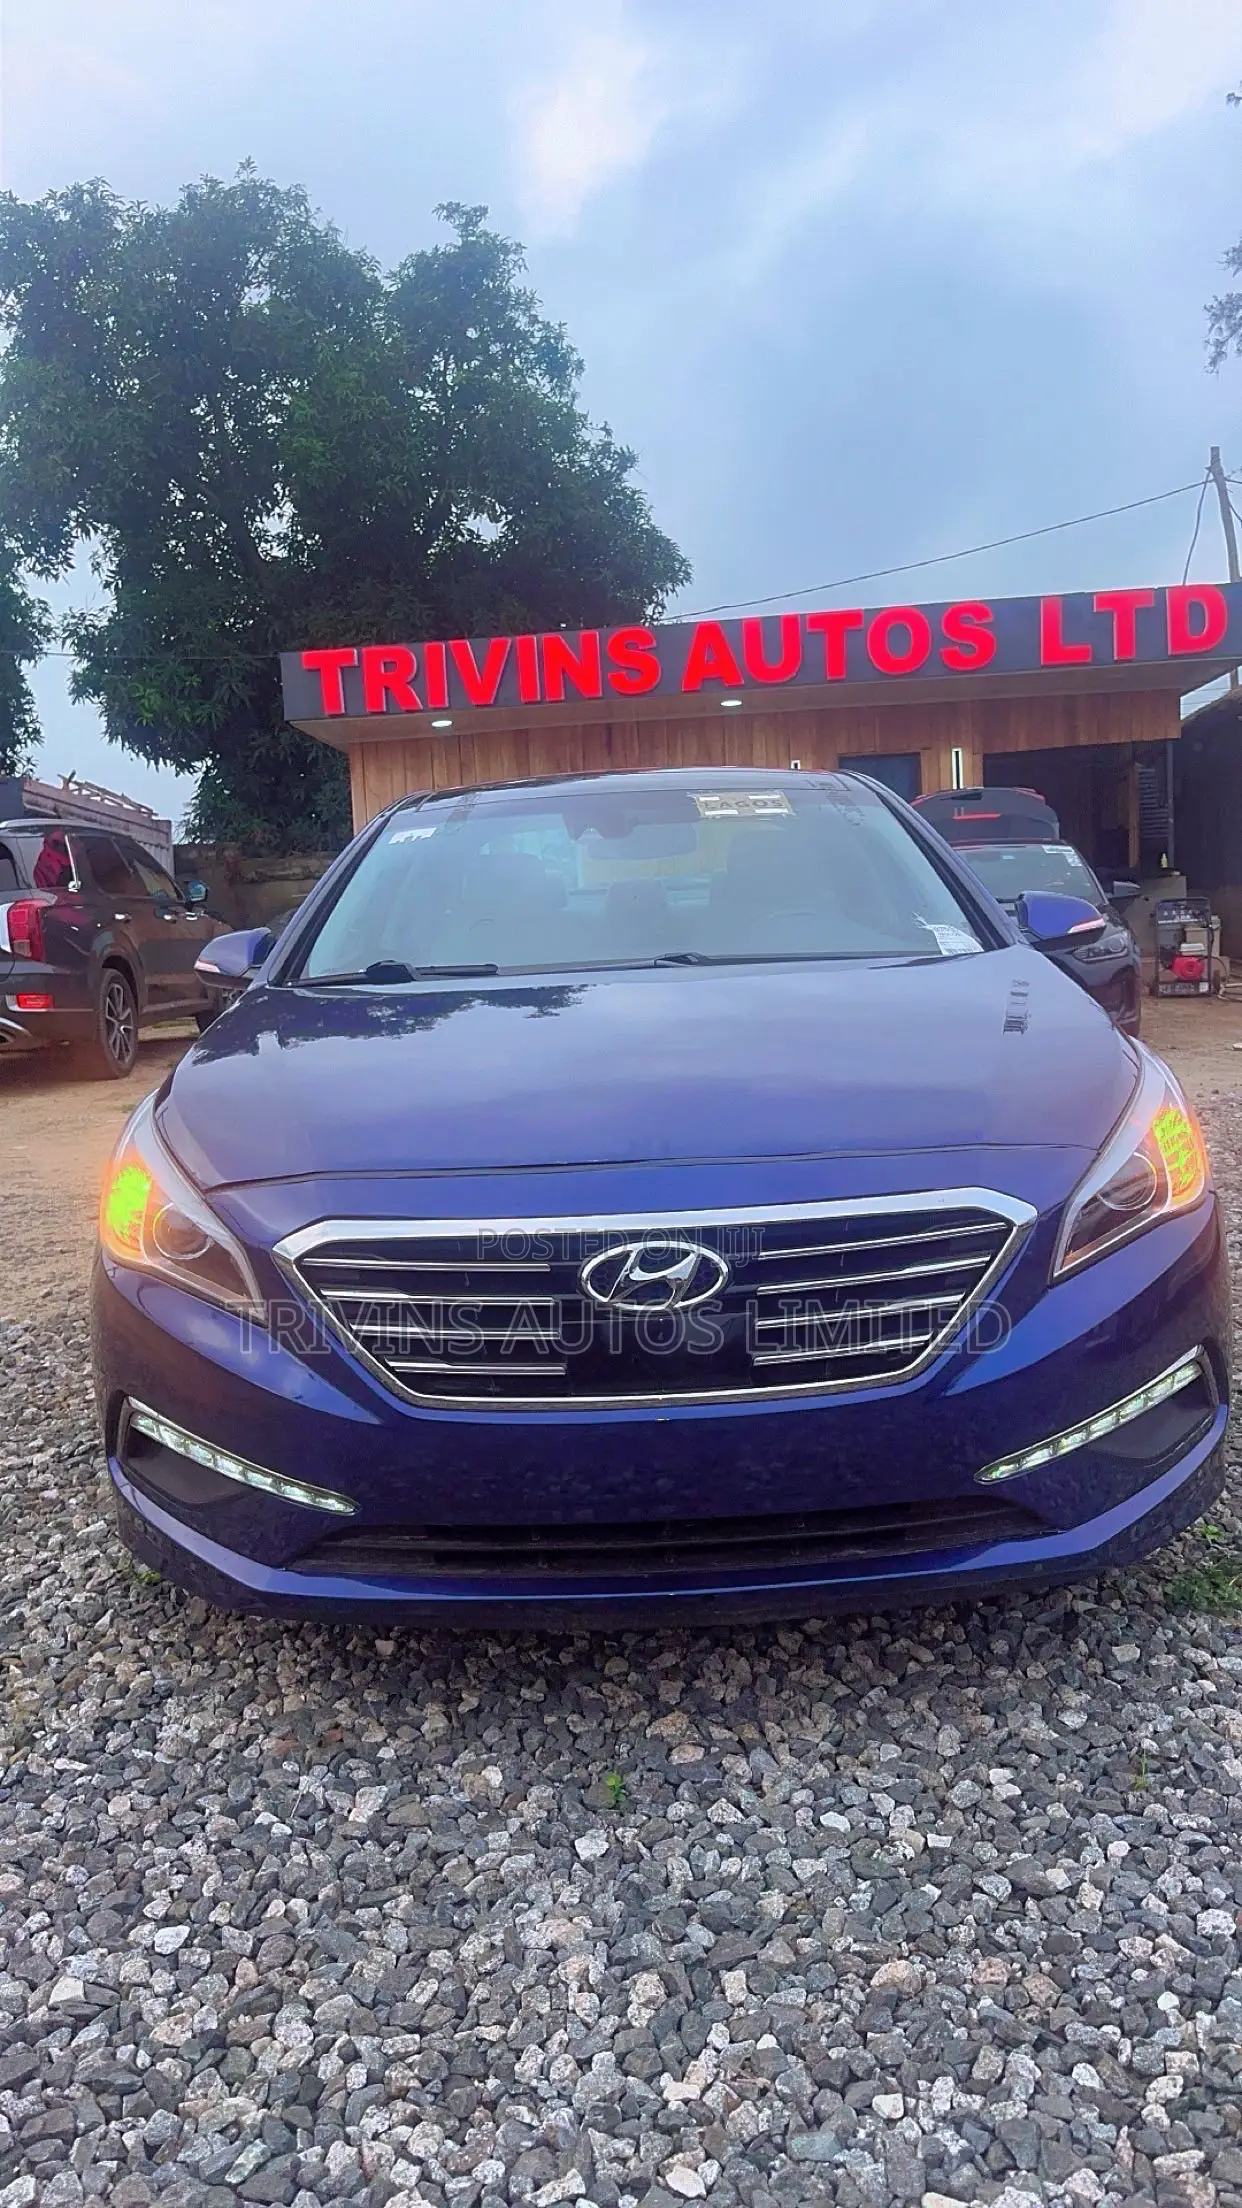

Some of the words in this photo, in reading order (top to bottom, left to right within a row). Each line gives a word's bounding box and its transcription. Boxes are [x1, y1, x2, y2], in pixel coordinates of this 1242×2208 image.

[302, 626, 661, 716] TRIVINS
[682, 601, 997, 692] AUTOS
[1040, 584, 1229, 666] LTD
[704, 799, 784, 810] LAGOS
